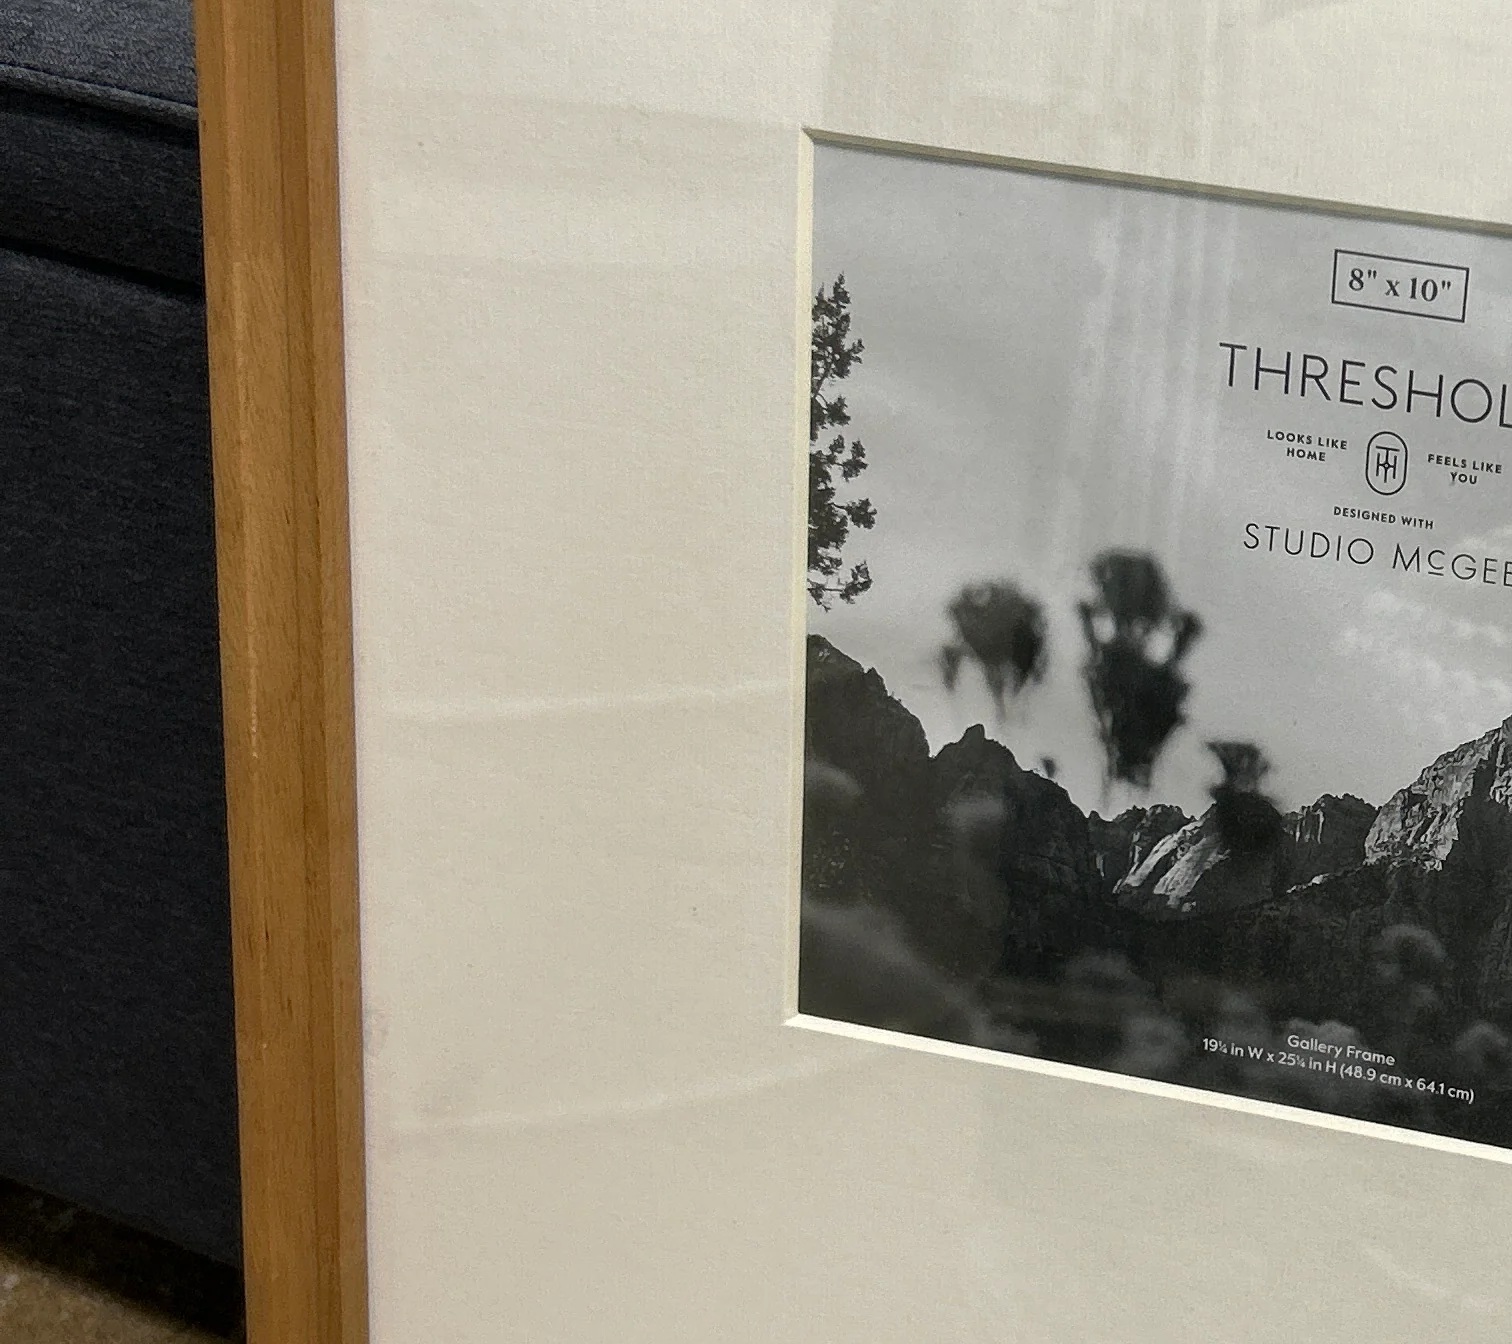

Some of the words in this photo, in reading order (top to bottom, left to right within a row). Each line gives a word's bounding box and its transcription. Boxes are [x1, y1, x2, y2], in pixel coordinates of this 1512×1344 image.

[1348, 268, 1378, 291] 8"
[1385, 279, 1400, 297] x
[1408, 276, 1452, 302] 10"
[1266, 429, 1313, 445] LOOKS
[1318, 436, 1348, 450] LIKE
[1286, 447, 1327, 462] HOME
[1427, 453, 1468, 469] FEELS
[1472, 460, 1503, 475] LIKE
[1449, 471, 1479, 485] YOU
[1333, 506, 1396, 524] DESIGNED
[1401, 515, 1435, 530] WITH
[1243, 523, 1375, 566] STUDIO
[1287, 1034, 1343, 1059] Gallery
[1346, 1045, 1396, 1066] Frame
[1230, 1042, 1245, 1057] in
[1247, 1045, 1264, 1060] W
[1266, 1052, 1275, 1063] x
[1308, 1056, 1322, 1071] in
[1325, 1059, 1337, 1074] H
[1339, 1062, 1377, 1082] (48.9
[1379, 1072, 1402, 1087] cm
[1404, 1077, 1414, 1089] x
[1416, 1077, 1445, 1095] 64.1
[1447, 1086, 1475, 1105] cm)
